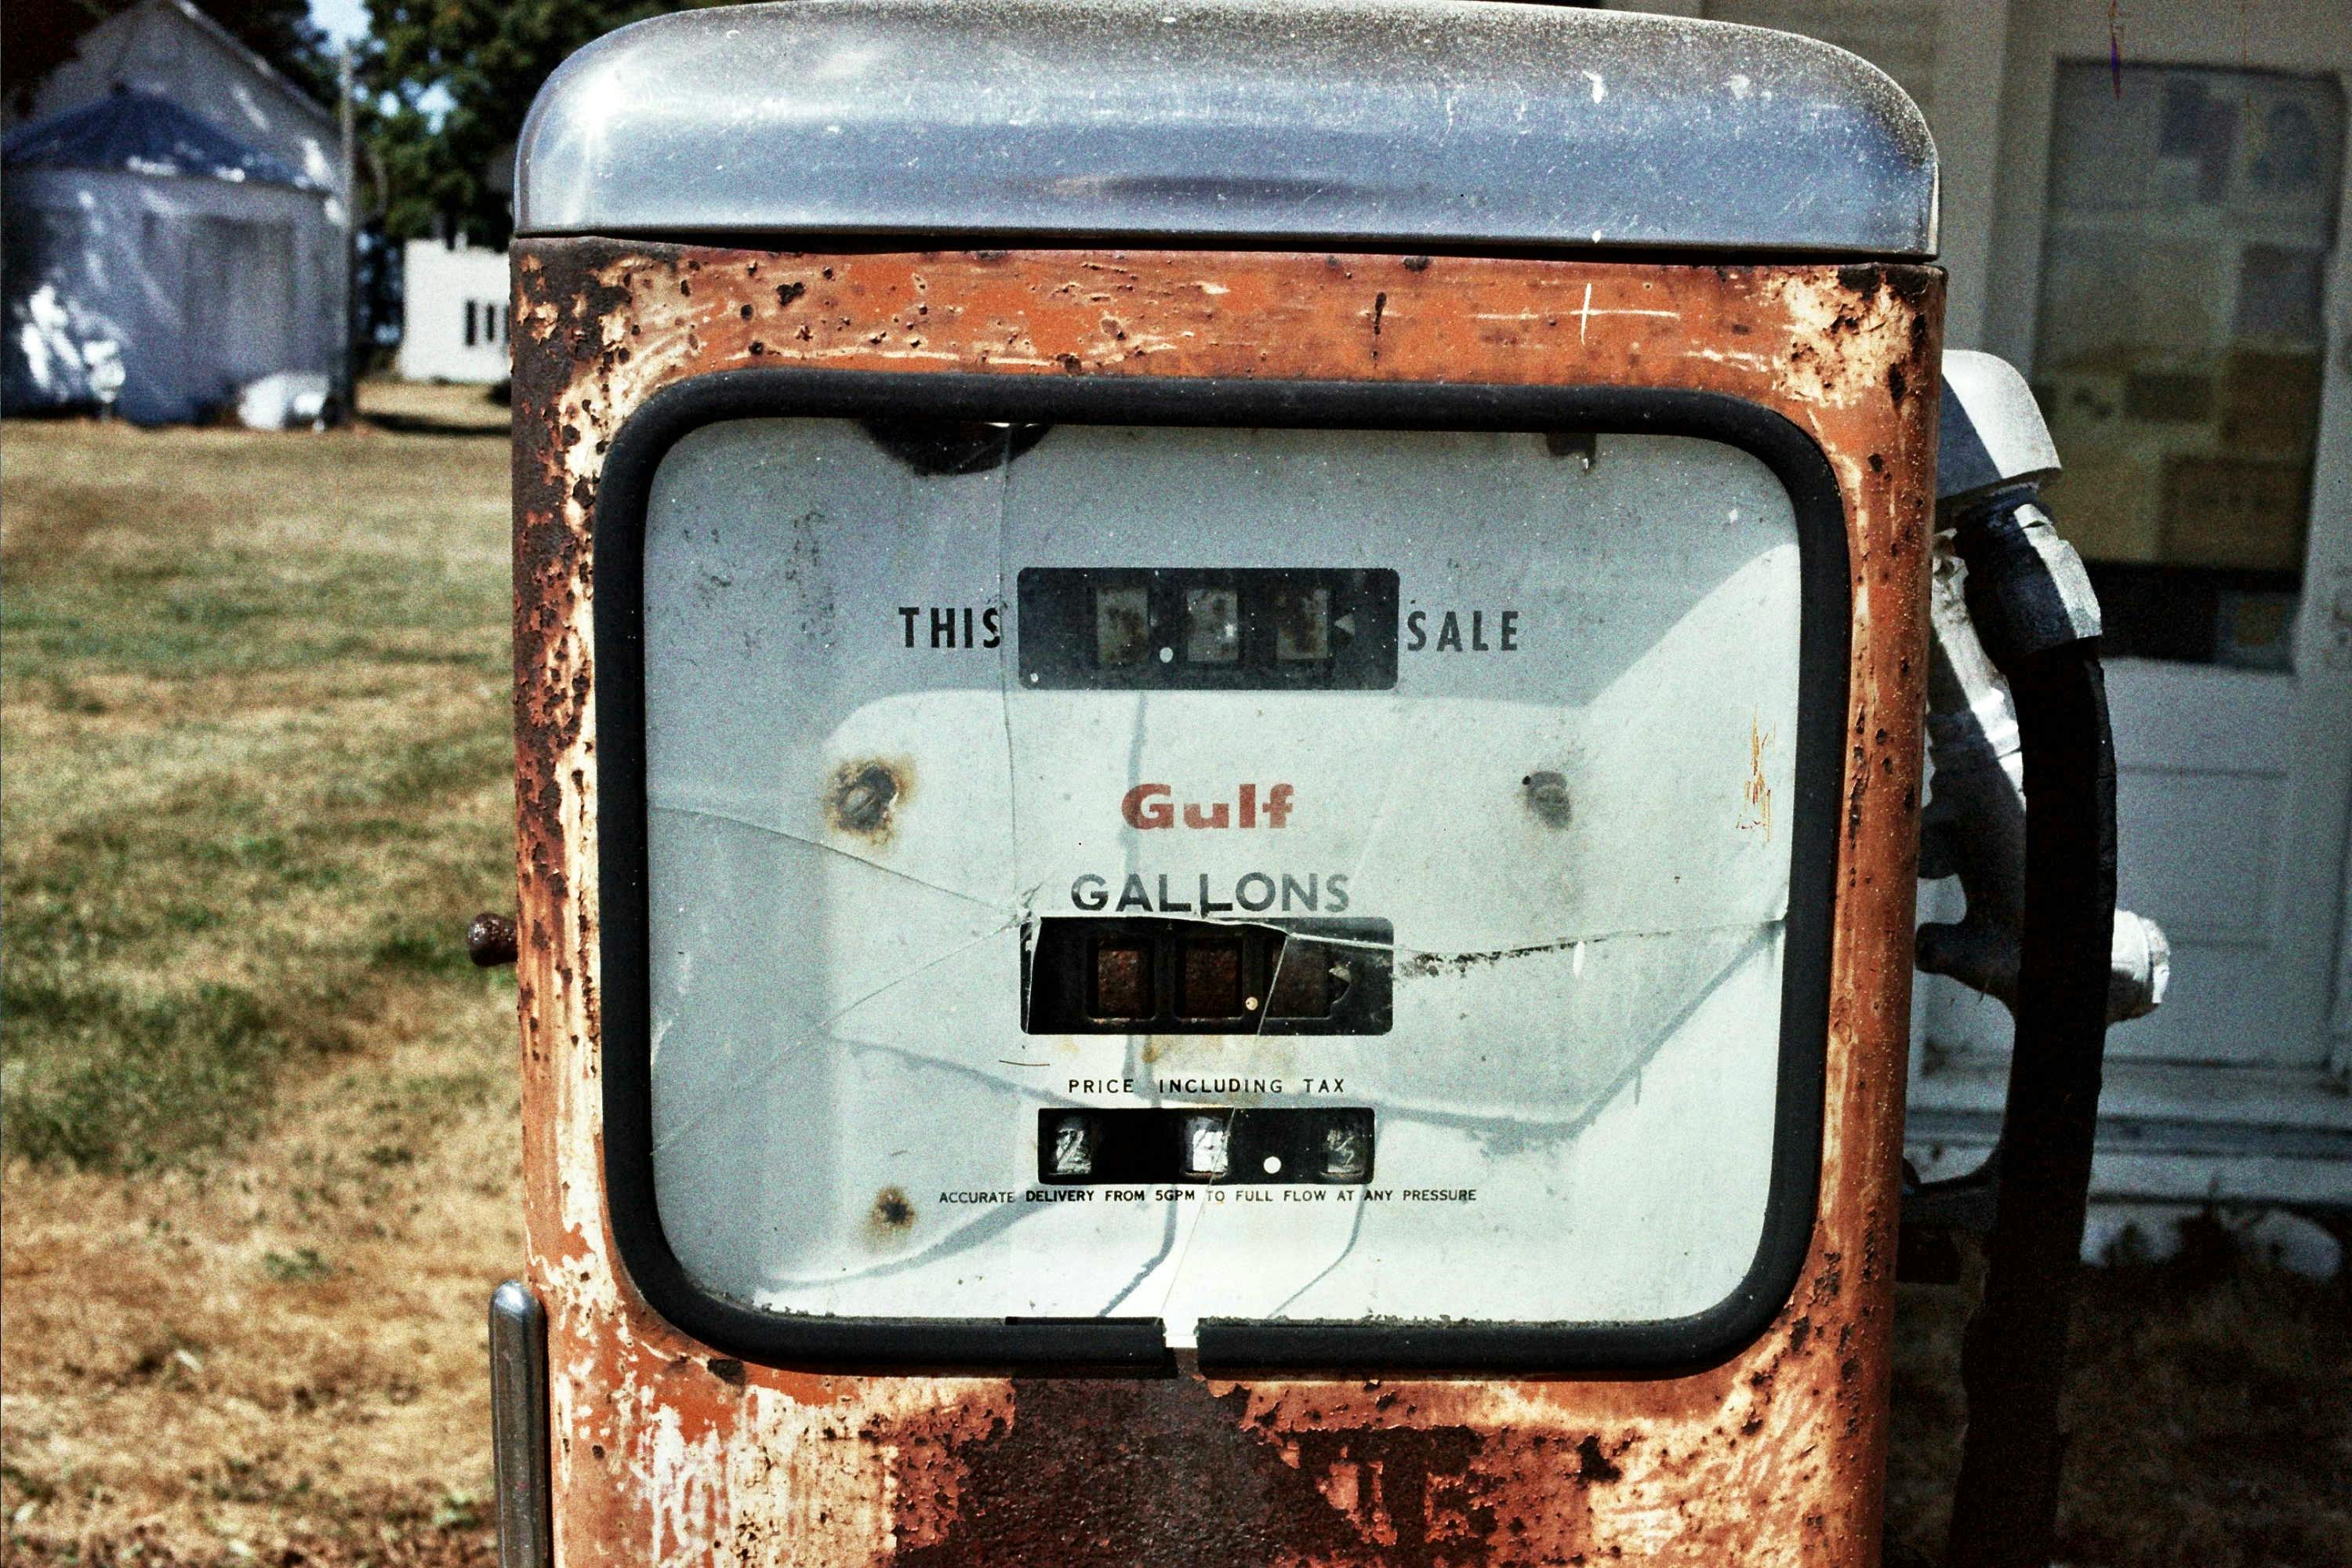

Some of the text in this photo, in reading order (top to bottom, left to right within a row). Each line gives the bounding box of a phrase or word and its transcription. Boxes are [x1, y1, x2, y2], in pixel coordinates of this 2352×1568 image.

[898, 607, 1519, 653] THIS SALE
[1122, 783, 1294, 830] Gulf
[1070, 872, 1349, 913] GALLONS
[1069, 1078, 1345, 1094] PRICE INCLUDING TAX
[938, 1189, 1477, 1204] ACCURATE DELIVERY FROM 5GPM TO FULL FLOW AT ANY PRESSURE
